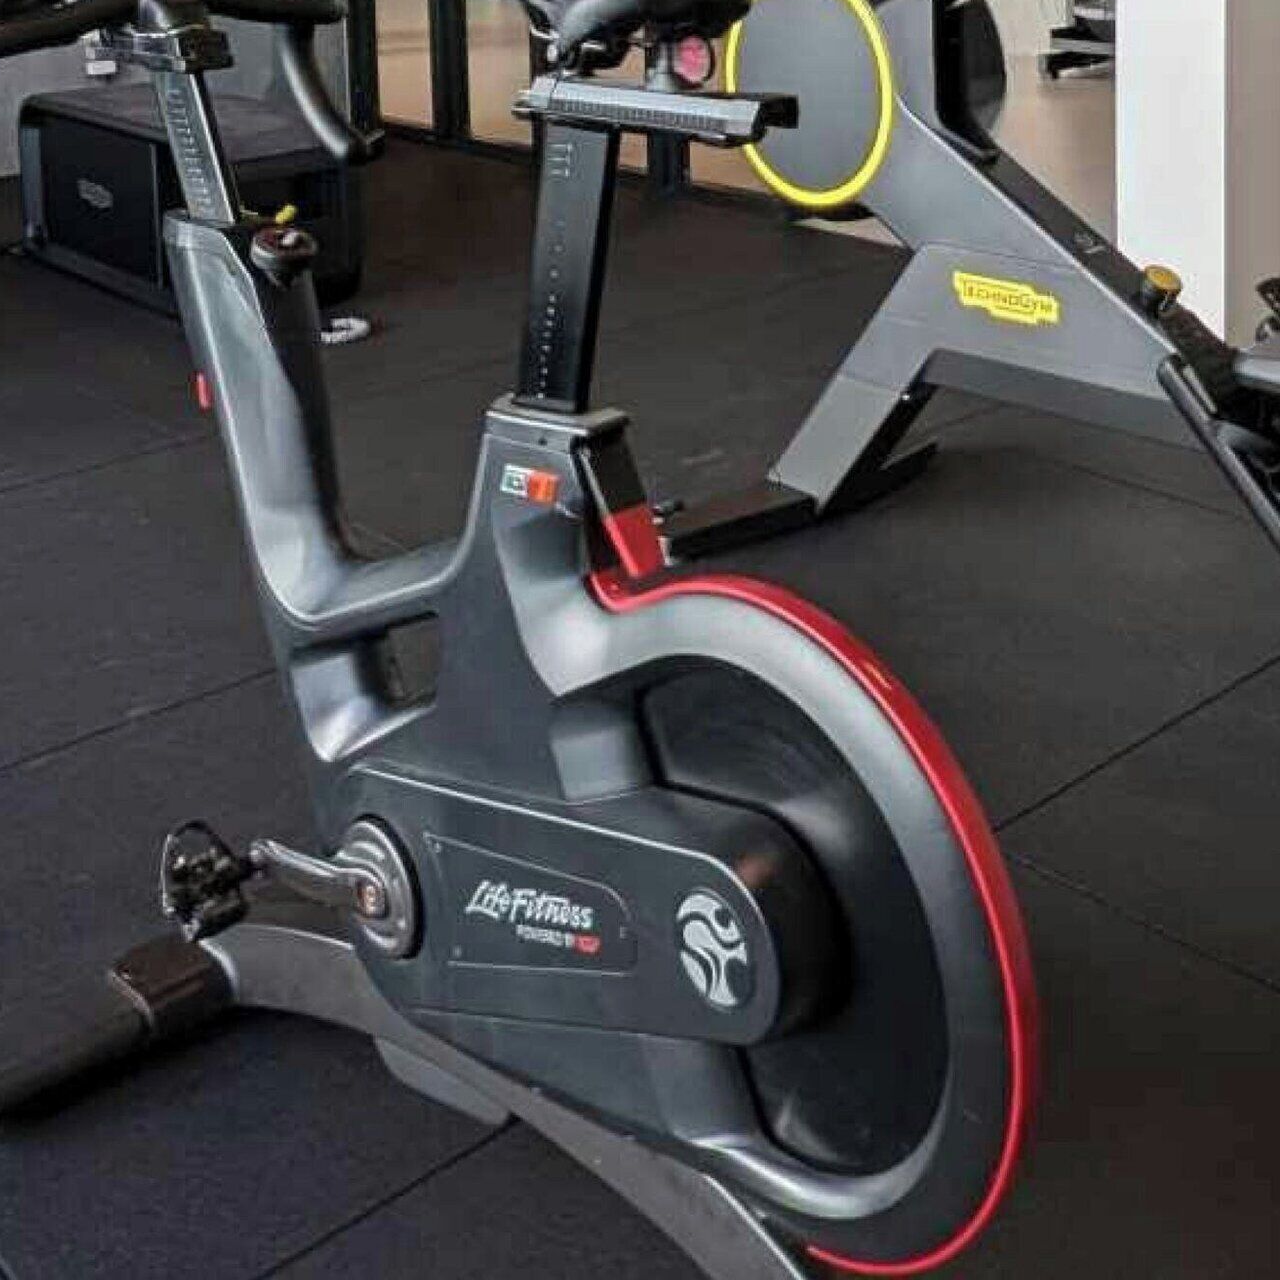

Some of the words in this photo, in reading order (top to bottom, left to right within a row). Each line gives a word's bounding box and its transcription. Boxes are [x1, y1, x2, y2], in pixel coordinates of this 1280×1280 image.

[959, 276, 1054, 313] TECHNOGYM
[465, 880, 510, 918] Life
[509, 888, 594, 928] Fitness
